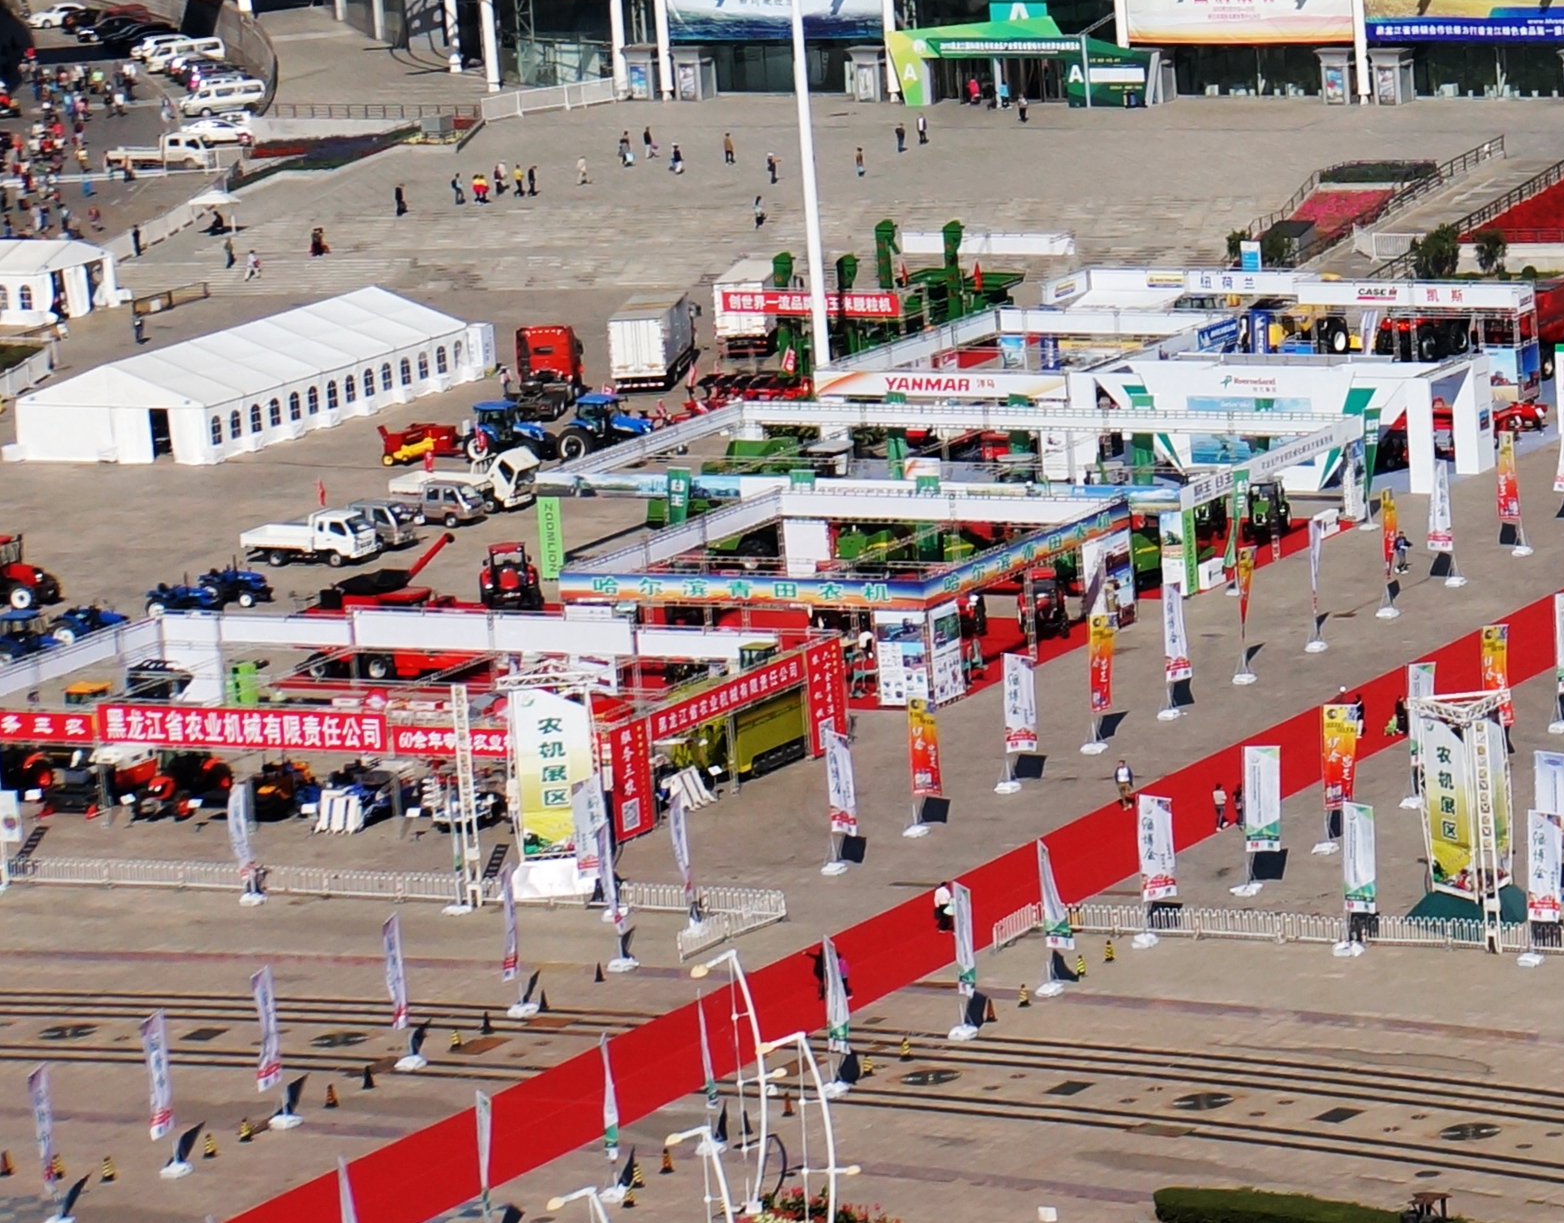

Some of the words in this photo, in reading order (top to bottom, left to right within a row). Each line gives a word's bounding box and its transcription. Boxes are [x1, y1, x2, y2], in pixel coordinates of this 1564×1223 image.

[903, 63, 919, 82] A
[1068, 64, 1085, 83] A
[1357, 287, 1387, 297] CASE
[1425, 287, 1465, 303] 凯斯
[885, 377, 970, 392] YANMAR
[543, 502, 559, 574] ZOOMLION
[942, 517, 1114, 594] 哈尔滨青田农机
[592, 577, 892, 603] 哈尔滨青田农机
[658, 662, 799, 734] 黑龙江省农业机械有限责任公司
[106, 708, 382, 749] 黑龙江省农业机械有限责任公司
[537, 716, 572, 807] 农机展区
[619, 729, 639, 797] 服务三农
[1436, 744, 1458, 841] 农机展区
